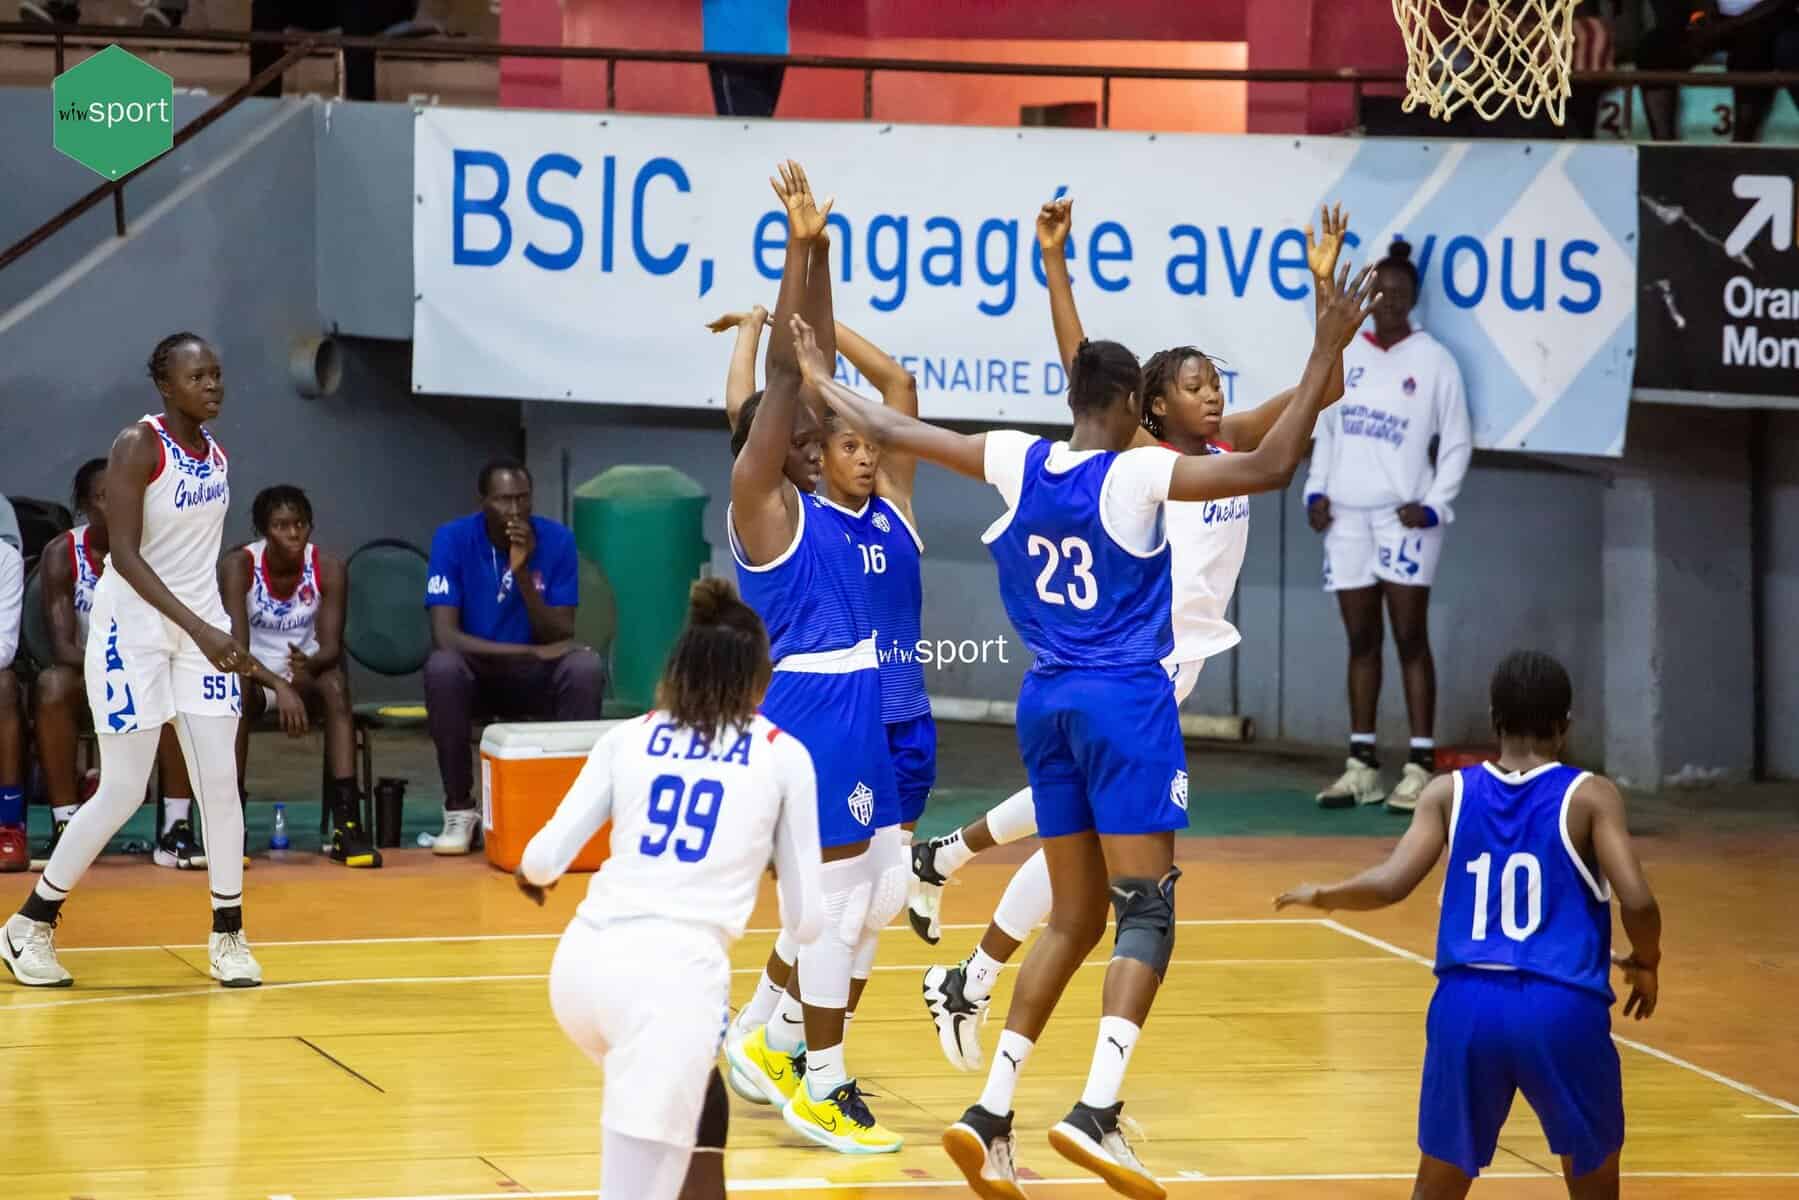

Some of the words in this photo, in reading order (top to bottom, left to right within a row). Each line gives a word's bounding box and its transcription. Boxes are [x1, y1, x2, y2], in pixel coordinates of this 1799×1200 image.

[1713, 104, 1732, 135] 3
[453, 148, 714, 298] BSIC,
[1166, 223, 1361, 301] ave
[1028, 534, 1098, 611] 23
[204, 675, 226, 700] 55
[640, 774, 724, 863] 99
[1466, 852, 1541, 941] 10
